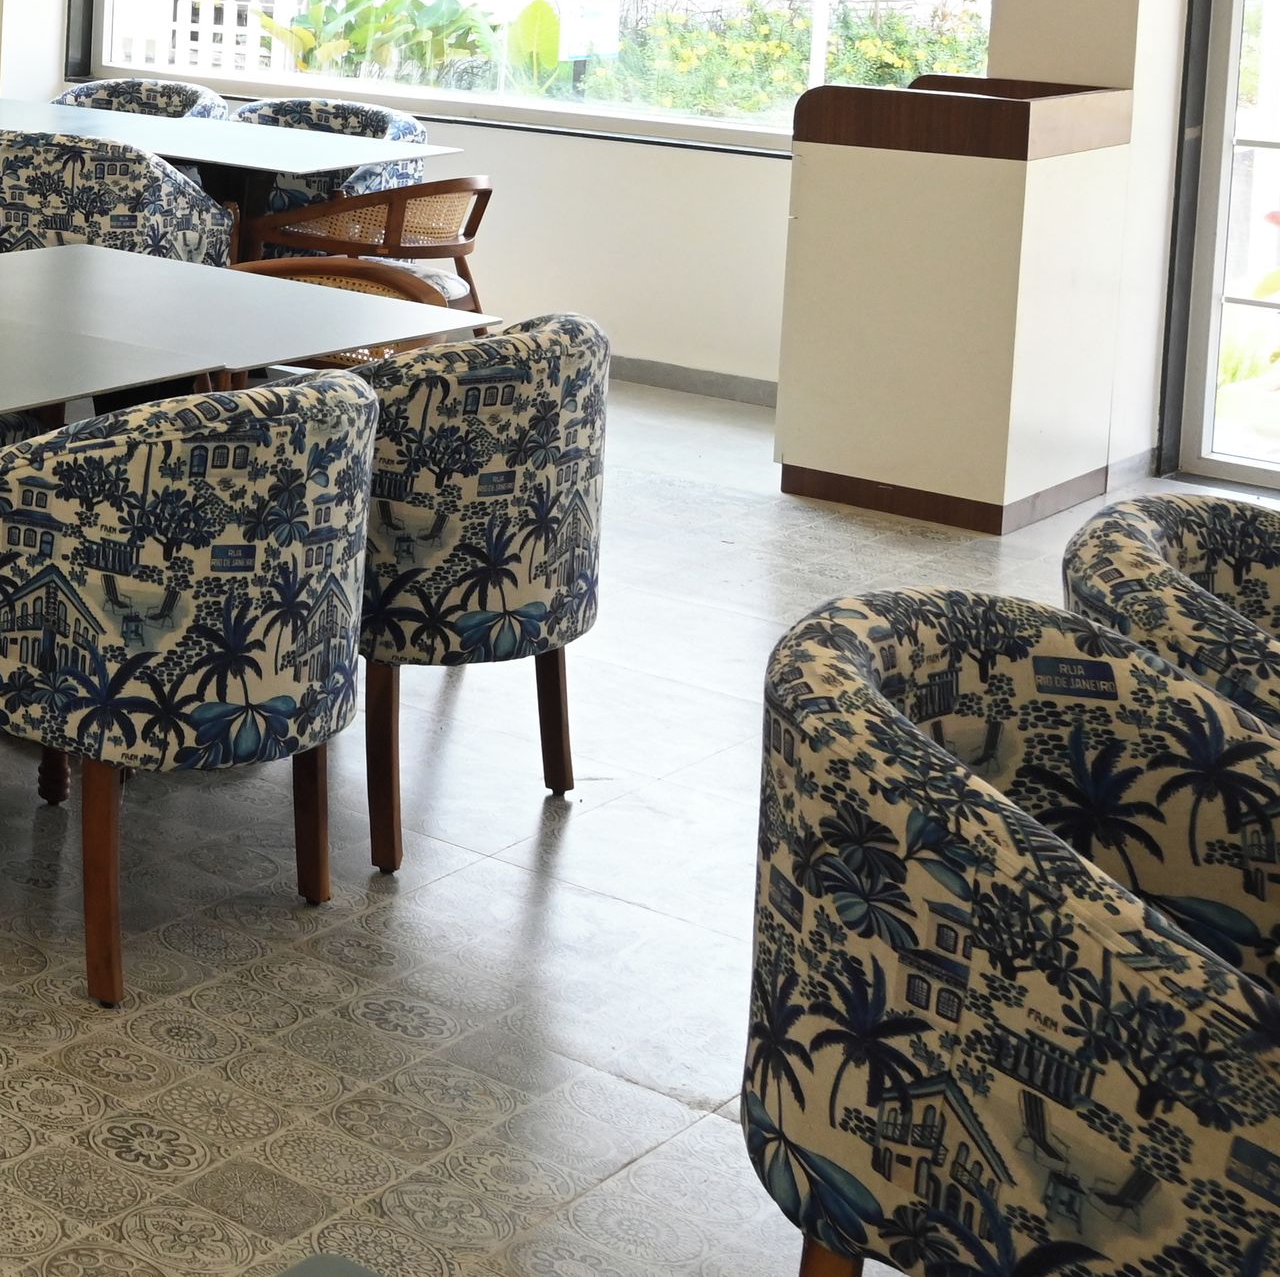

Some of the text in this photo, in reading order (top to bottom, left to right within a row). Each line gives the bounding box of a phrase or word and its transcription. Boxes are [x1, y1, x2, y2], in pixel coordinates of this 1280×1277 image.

[1059, 664, 1086, 676] RUA
[1035, 674, 1116, 693] RIO DE JANEIRO
[1027, 1007, 1058, 1033] FARM
